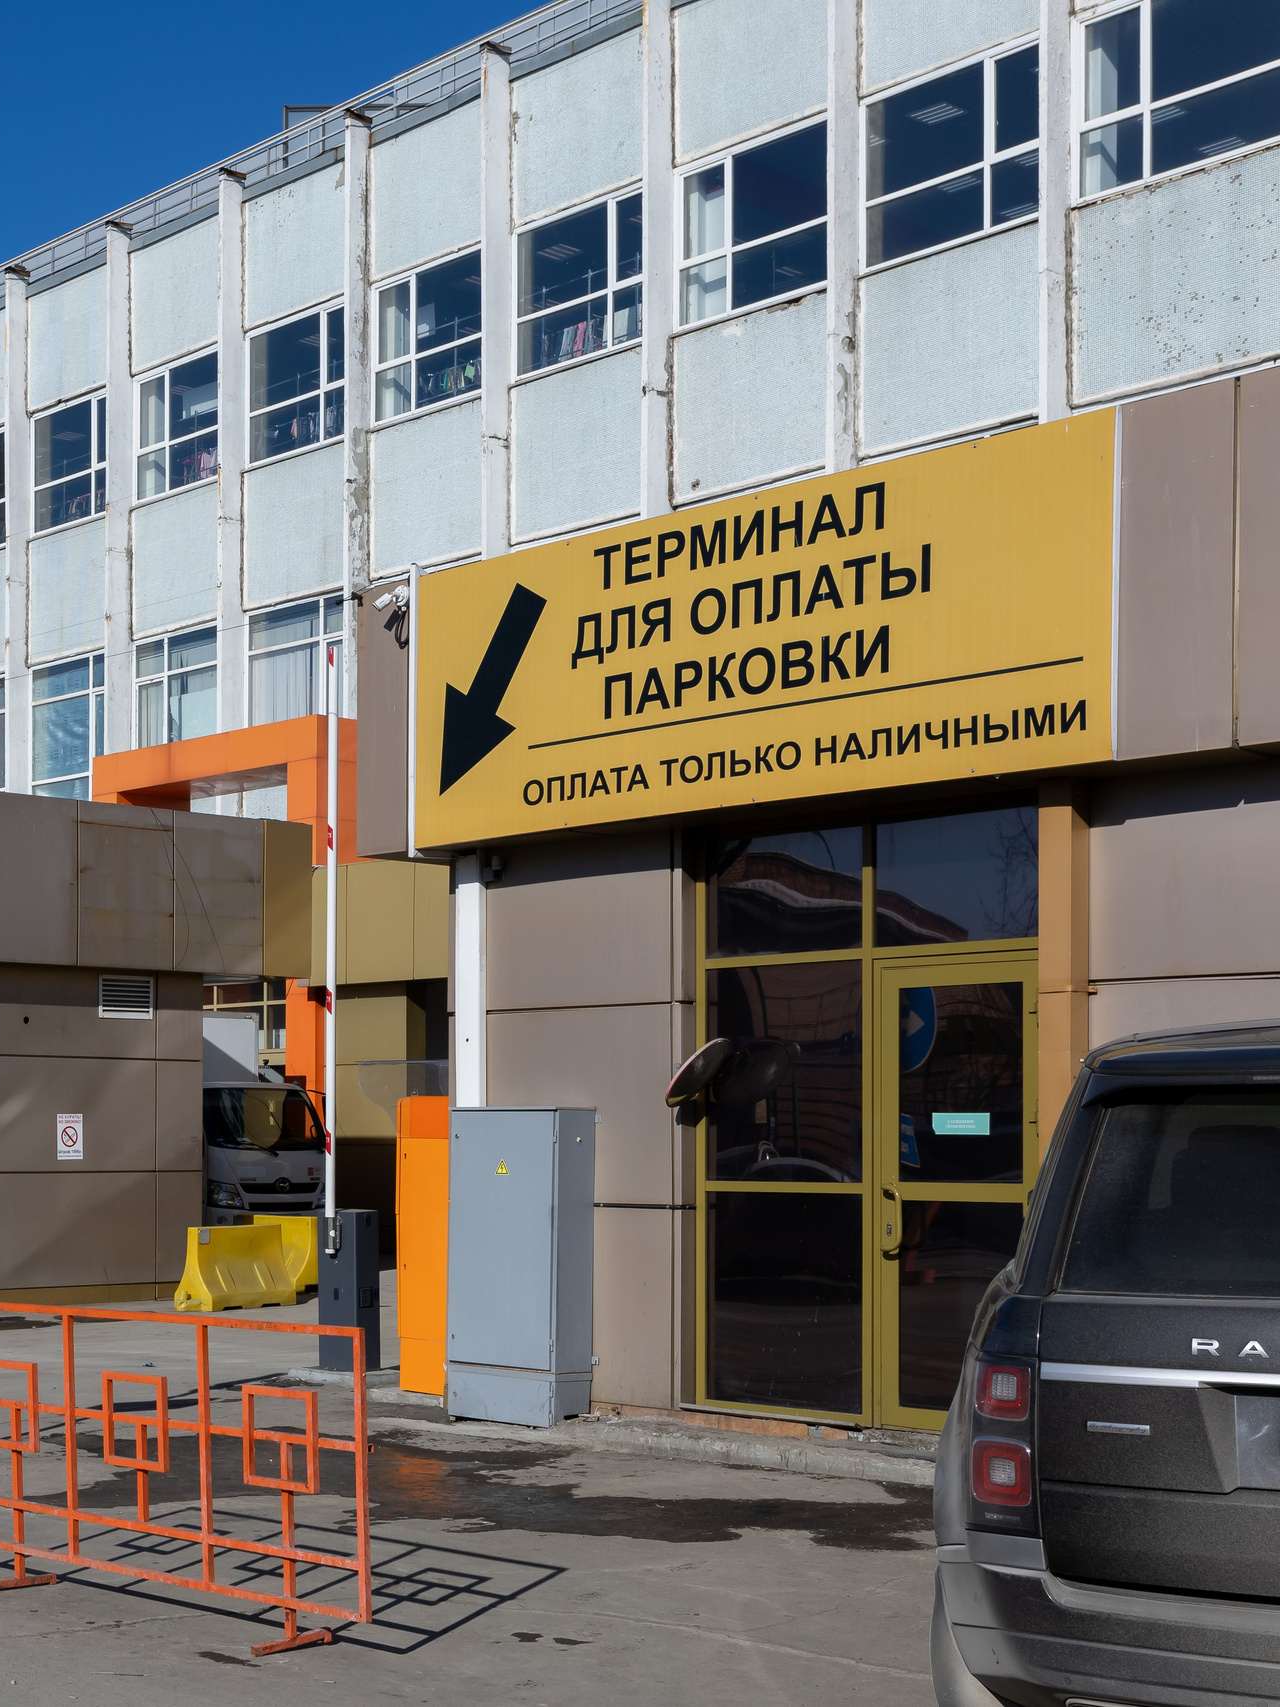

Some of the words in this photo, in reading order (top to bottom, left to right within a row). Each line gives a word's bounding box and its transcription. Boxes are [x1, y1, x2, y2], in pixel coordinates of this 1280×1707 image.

[593, 481, 886, 590] ТЕРМИНАЛ
[570, 597, 671, 669] ДЛЯ
[690, 543, 931, 636] ОПЛАТЫ
[604, 624, 890, 719] ПАРКОВКИ
[523, 764, 650, 806] ОПЛАТА
[663, 739, 801, 785] ТОЛЬКО
[816, 699, 1087, 764] НАЛИЧНЫМИ
